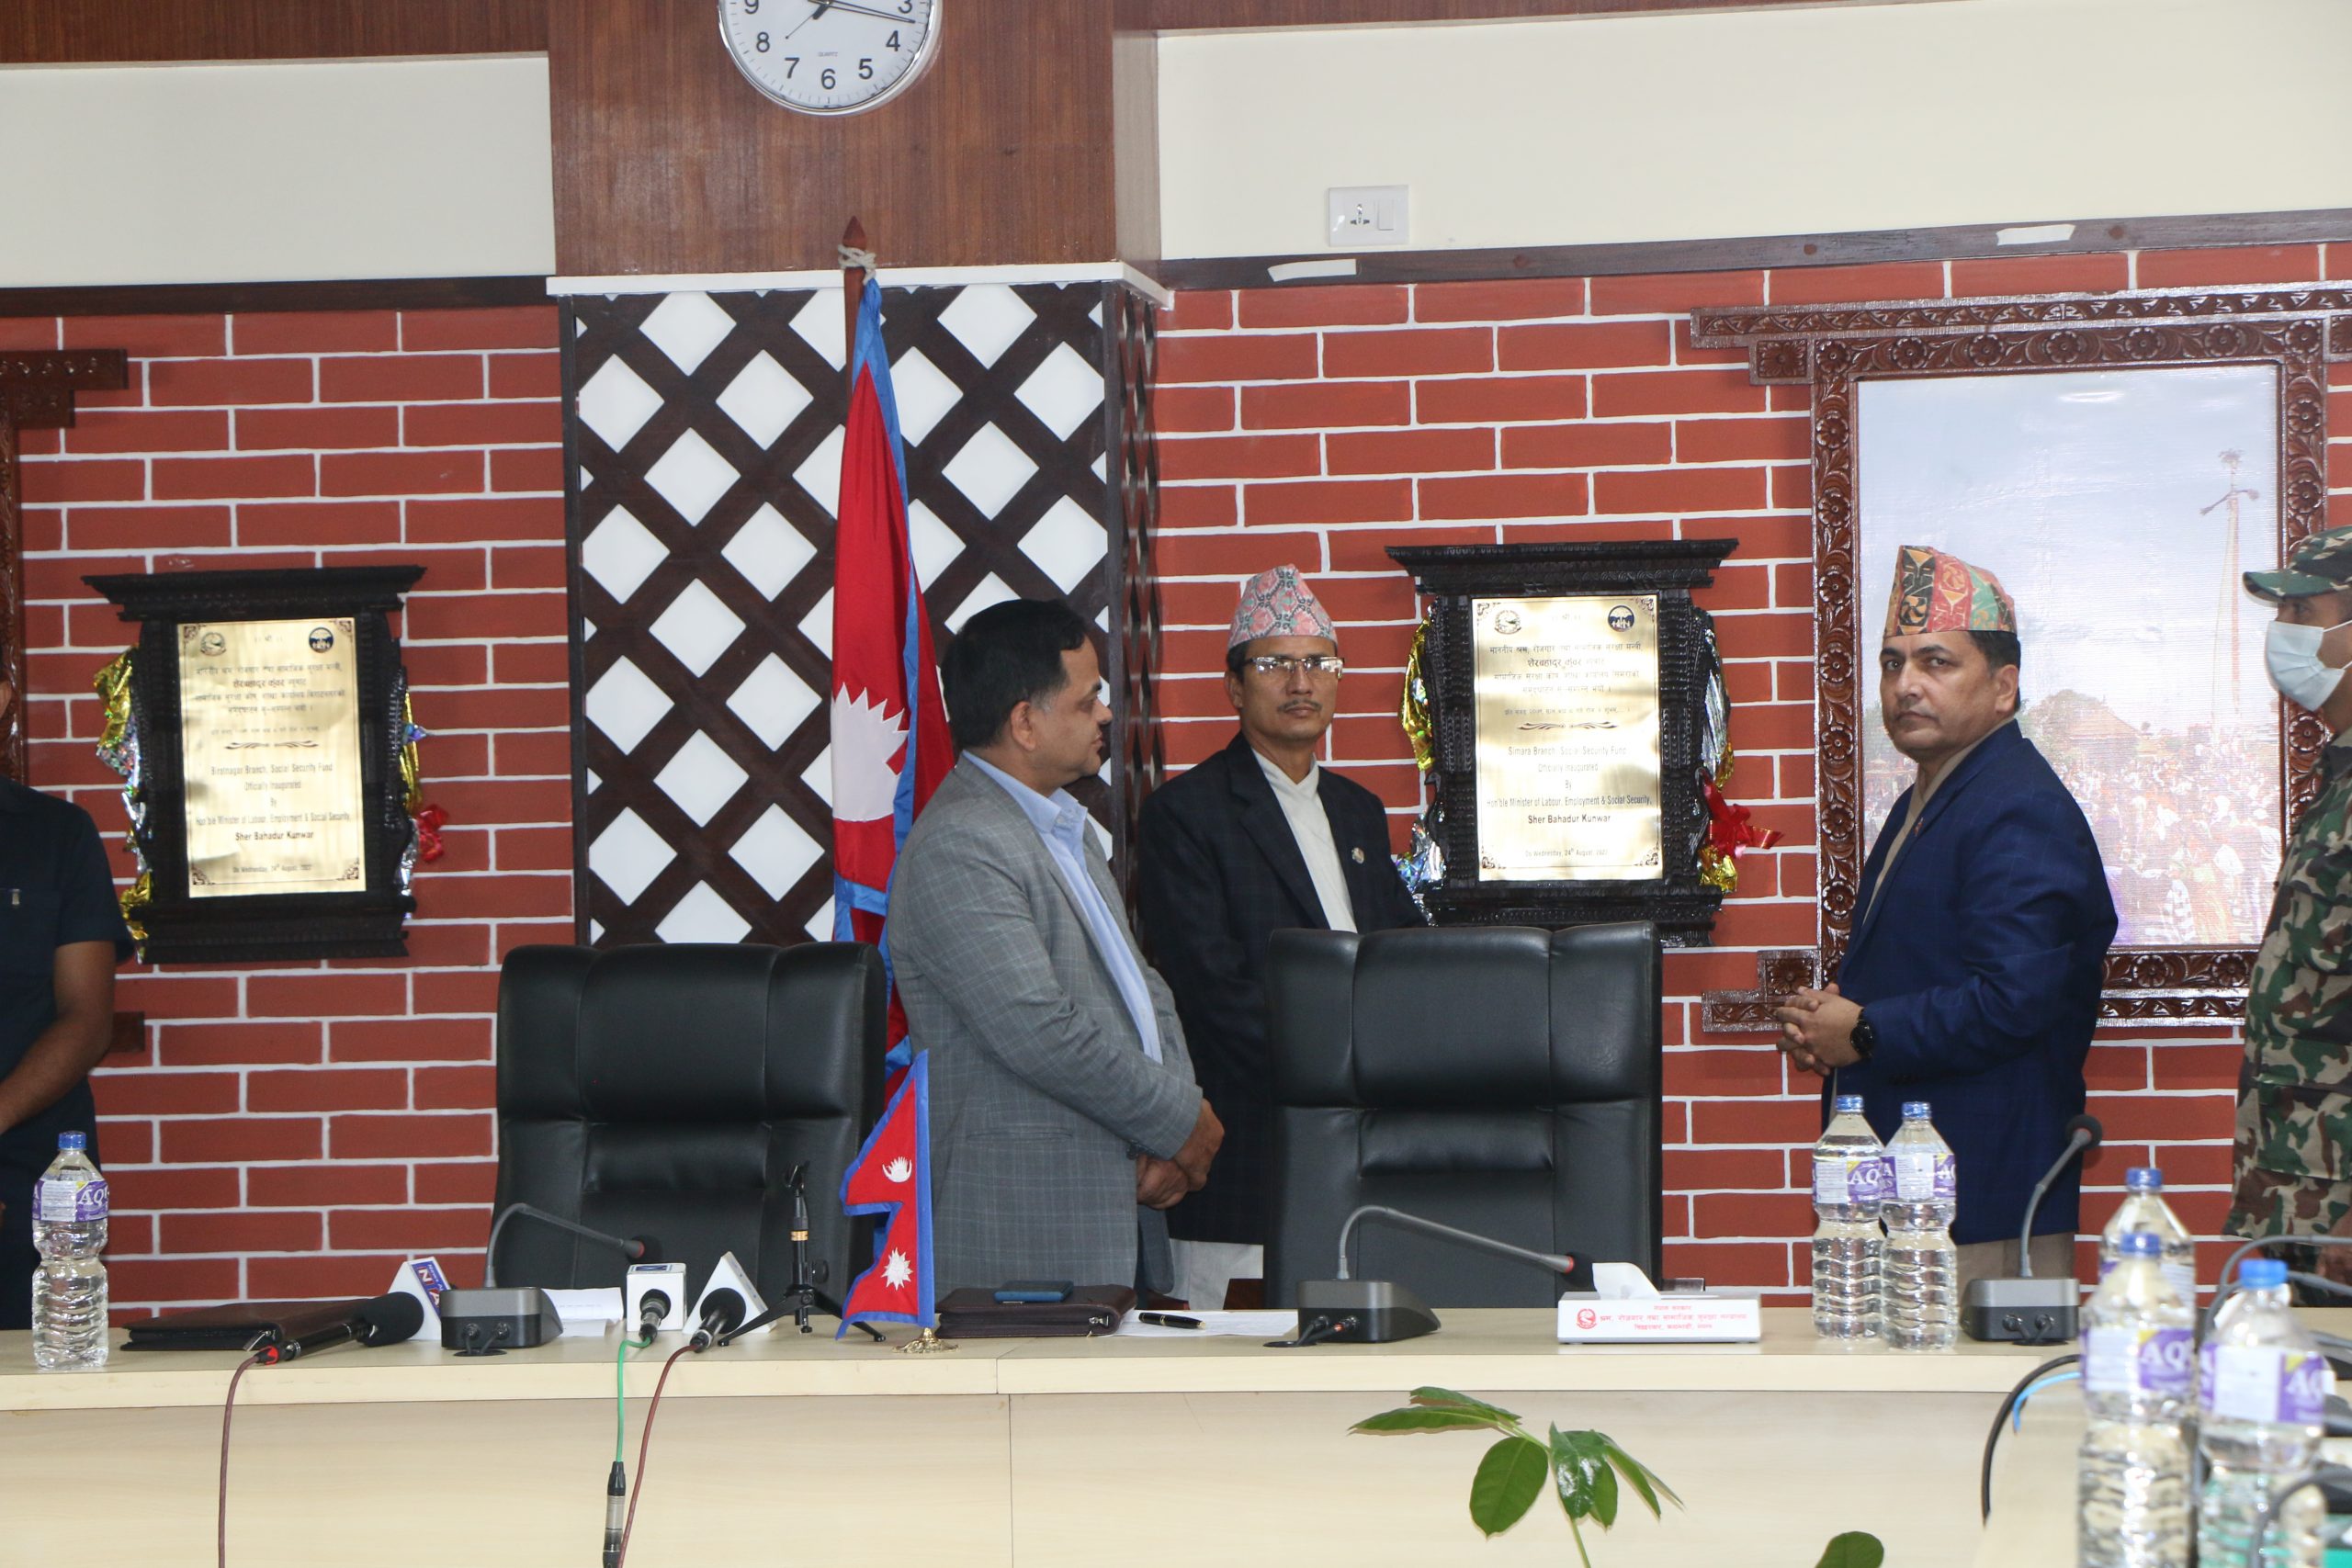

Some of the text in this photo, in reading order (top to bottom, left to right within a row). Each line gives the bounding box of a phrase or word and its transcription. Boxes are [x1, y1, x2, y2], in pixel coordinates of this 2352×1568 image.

[744, 0, 760, 15] 9
[897, 0, 912, 15] 3
[756, 31, 770, 53] 8
[885, 29, 900, 52] 4
[784, 57, 800, 79] 7
[858, 58, 874, 80] 5
[820, 68, 836, 90] 6
[1508, 746, 1532, 756] Simara
[1510, 797, 1532, 807] Minister
[1565, 795, 1600, 807] Employment
[1601, 795, 1606, 805] &
[1607, 795, 1625, 806] Social
[1627, 795, 1652, 807] Security,
[1527, 813, 1611, 824] Sher Bahadur Kunwar
[235, 830, 314, 841] Sher Bahadur Kunwar
